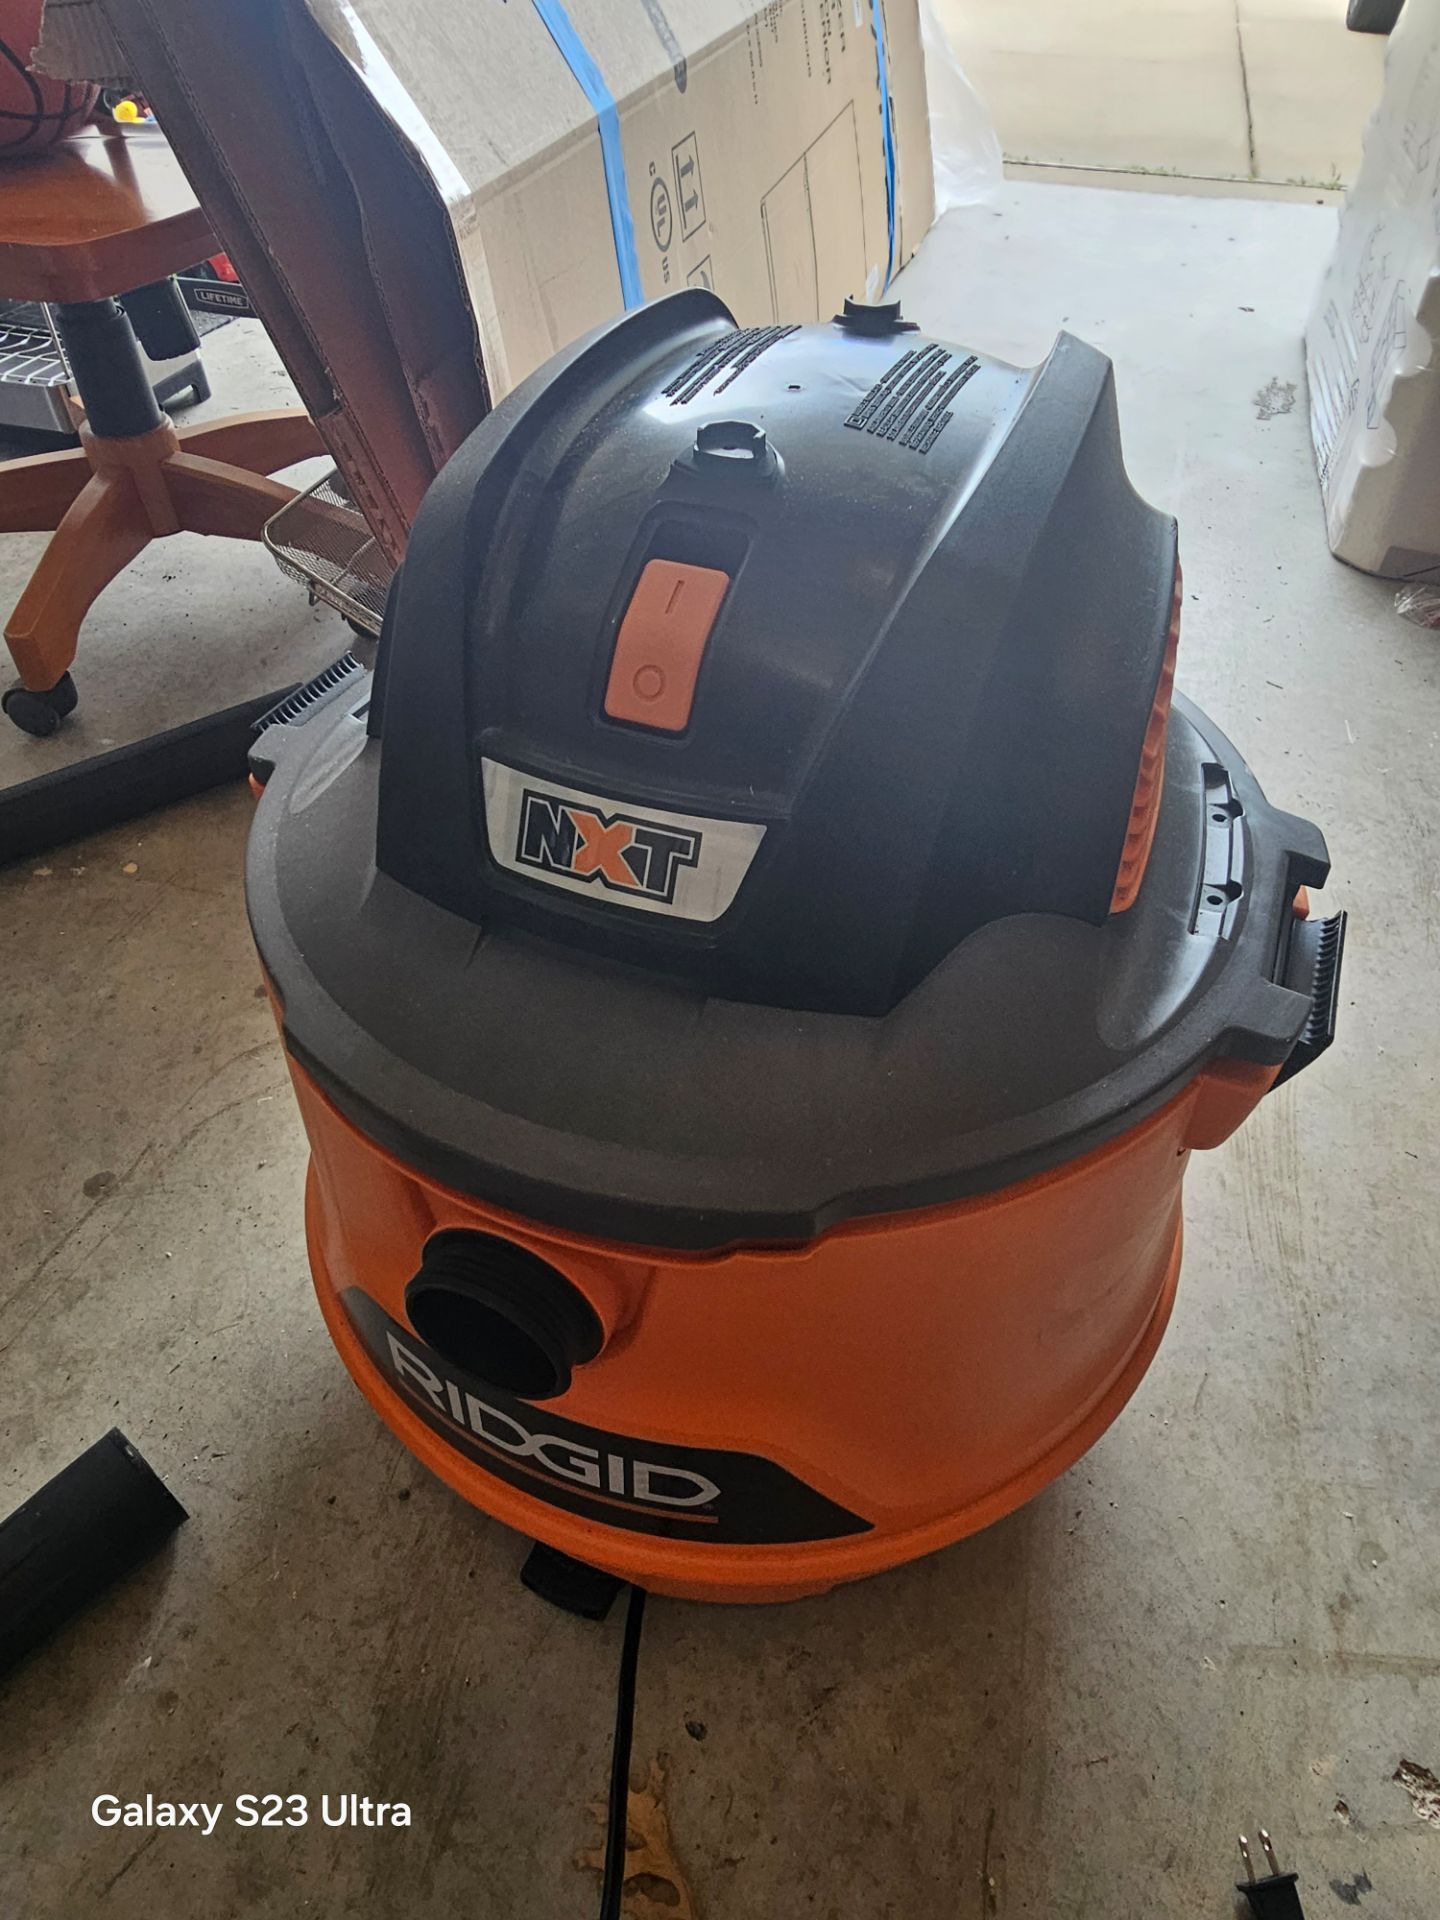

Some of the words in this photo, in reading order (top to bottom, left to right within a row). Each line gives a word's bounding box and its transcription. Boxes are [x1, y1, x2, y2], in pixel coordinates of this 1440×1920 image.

[201, 291, 243, 306] LIFETIME
[517, 790, 702, 903] NXT
[386, 1330, 721, 1507] RIDGID
